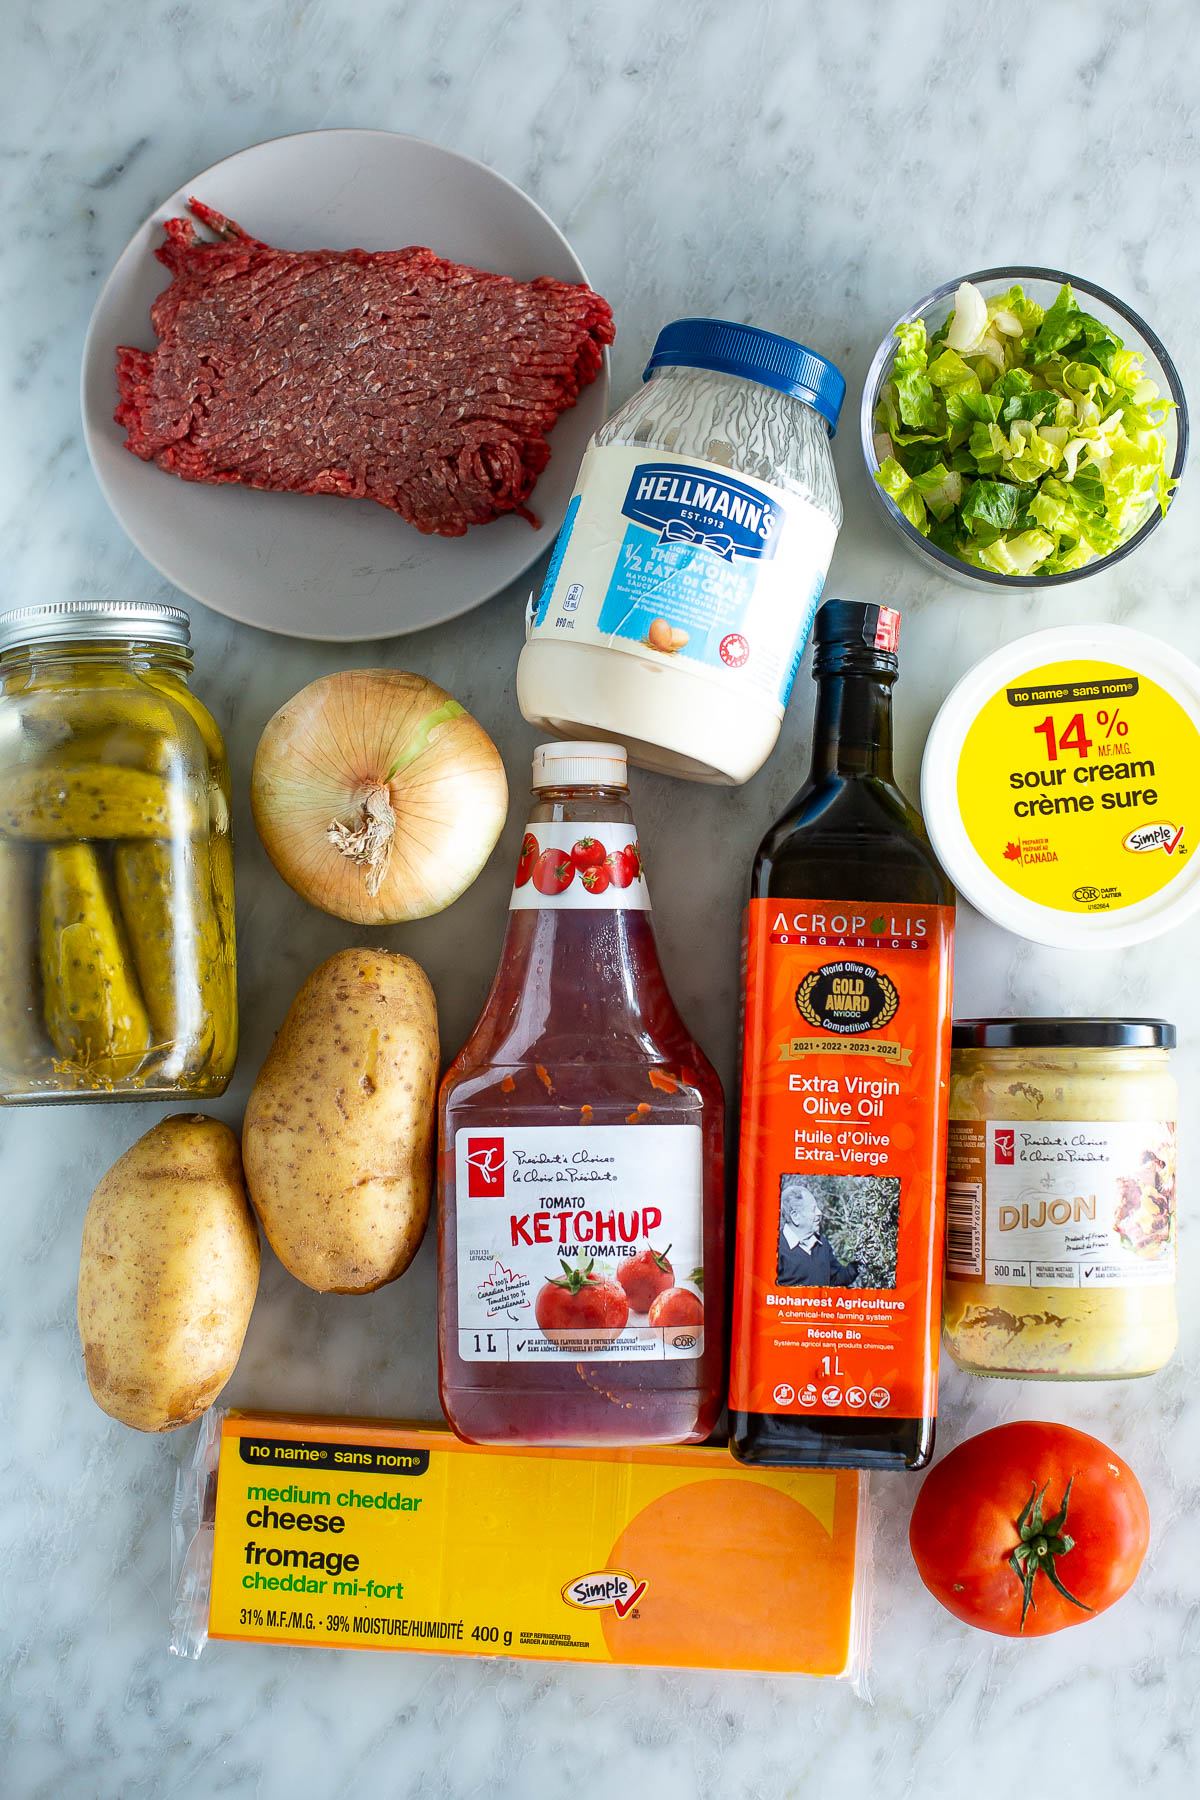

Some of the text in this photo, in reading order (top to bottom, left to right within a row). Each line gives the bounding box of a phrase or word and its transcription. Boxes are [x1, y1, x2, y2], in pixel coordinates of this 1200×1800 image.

[635, 477, 776, 540] HELLMANN'S
[680, 509, 725, 529] EST.1913
[651, 547, 679, 566] THE
[1014, 691, 1029, 702] no
[1072, 685, 1100, 697] sans
[1033, 708, 1129, 762] 14 %
[1009, 759, 1156, 790] sour cream
[1013, 787, 1158, 818] crème sure
[1130, 826, 1171, 850] Simple
[1024, 851, 1059, 864] CANADA
[780, 934, 918, 949] ORGANICS
[820, 962, 876, 979] World Olive Oil
[832, 977, 864, 995] GOLD
[825, 994, 870, 1012] AWARD
[822, 1018, 871, 1033] Competition
[793, 1042, 897, 1055] 2021 2022 2023 2024
[788, 1074, 900, 1098] Extra Virgin
[802, 1097, 884, 1117] Olive Oil
[794, 1129, 890, 1146] Huile d'Olive
[794, 1146, 889, 1166] Extra-Vierge
[513, 1170, 522, 1182] le
[523, 1171, 553, 1182] Choix
[539, 1196, 585, 1209] TOMATO
[999, 1194, 1097, 1232] DIJON
[510, 1206, 662, 1246] KETCHUP
[557, 1244, 637, 1257] AUX TOMATES
[994, 1265, 1026, 1277] 500 mL
[478, 1279, 530, 1299] Canadian tomatoes
[486, 1294, 509, 1305] Tomates
[491, 1298, 525, 1312] canadiennes
[766, 1294, 905, 1310] Bioharvest Agriculture
[785, 1310, 835, 1319] chemical-free
[836, 1311, 864, 1321] farming
[865, 1313, 892, 1321] system
[807, 1328, 861, 1340] Récolte Bio
[863, 1342, 894, 1350] chimiques
[849, 1391, 863, 1403] K
[250, 1444, 270, 1458] no
[334, 1450, 372, 1465] sans
[247, 1485, 423, 1511] medium cheddar
[246, 1505, 346, 1534] cheese
[244, 1541, 360, 1577] fromage
[242, 1571, 404, 1600] cheddar mi-fort
[573, 1576, 628, 1602] Simple
[239, 1608, 464, 1640] 31% M.F./M.G. 39% MOISTURE/HUMIDITÉ
[471, 1625, 513, 1647] 400 g
[533, 1632, 571, 1641] REFRIGERATED
[549, 1639, 590, 1648] RÉFRIGÉRATEUR
